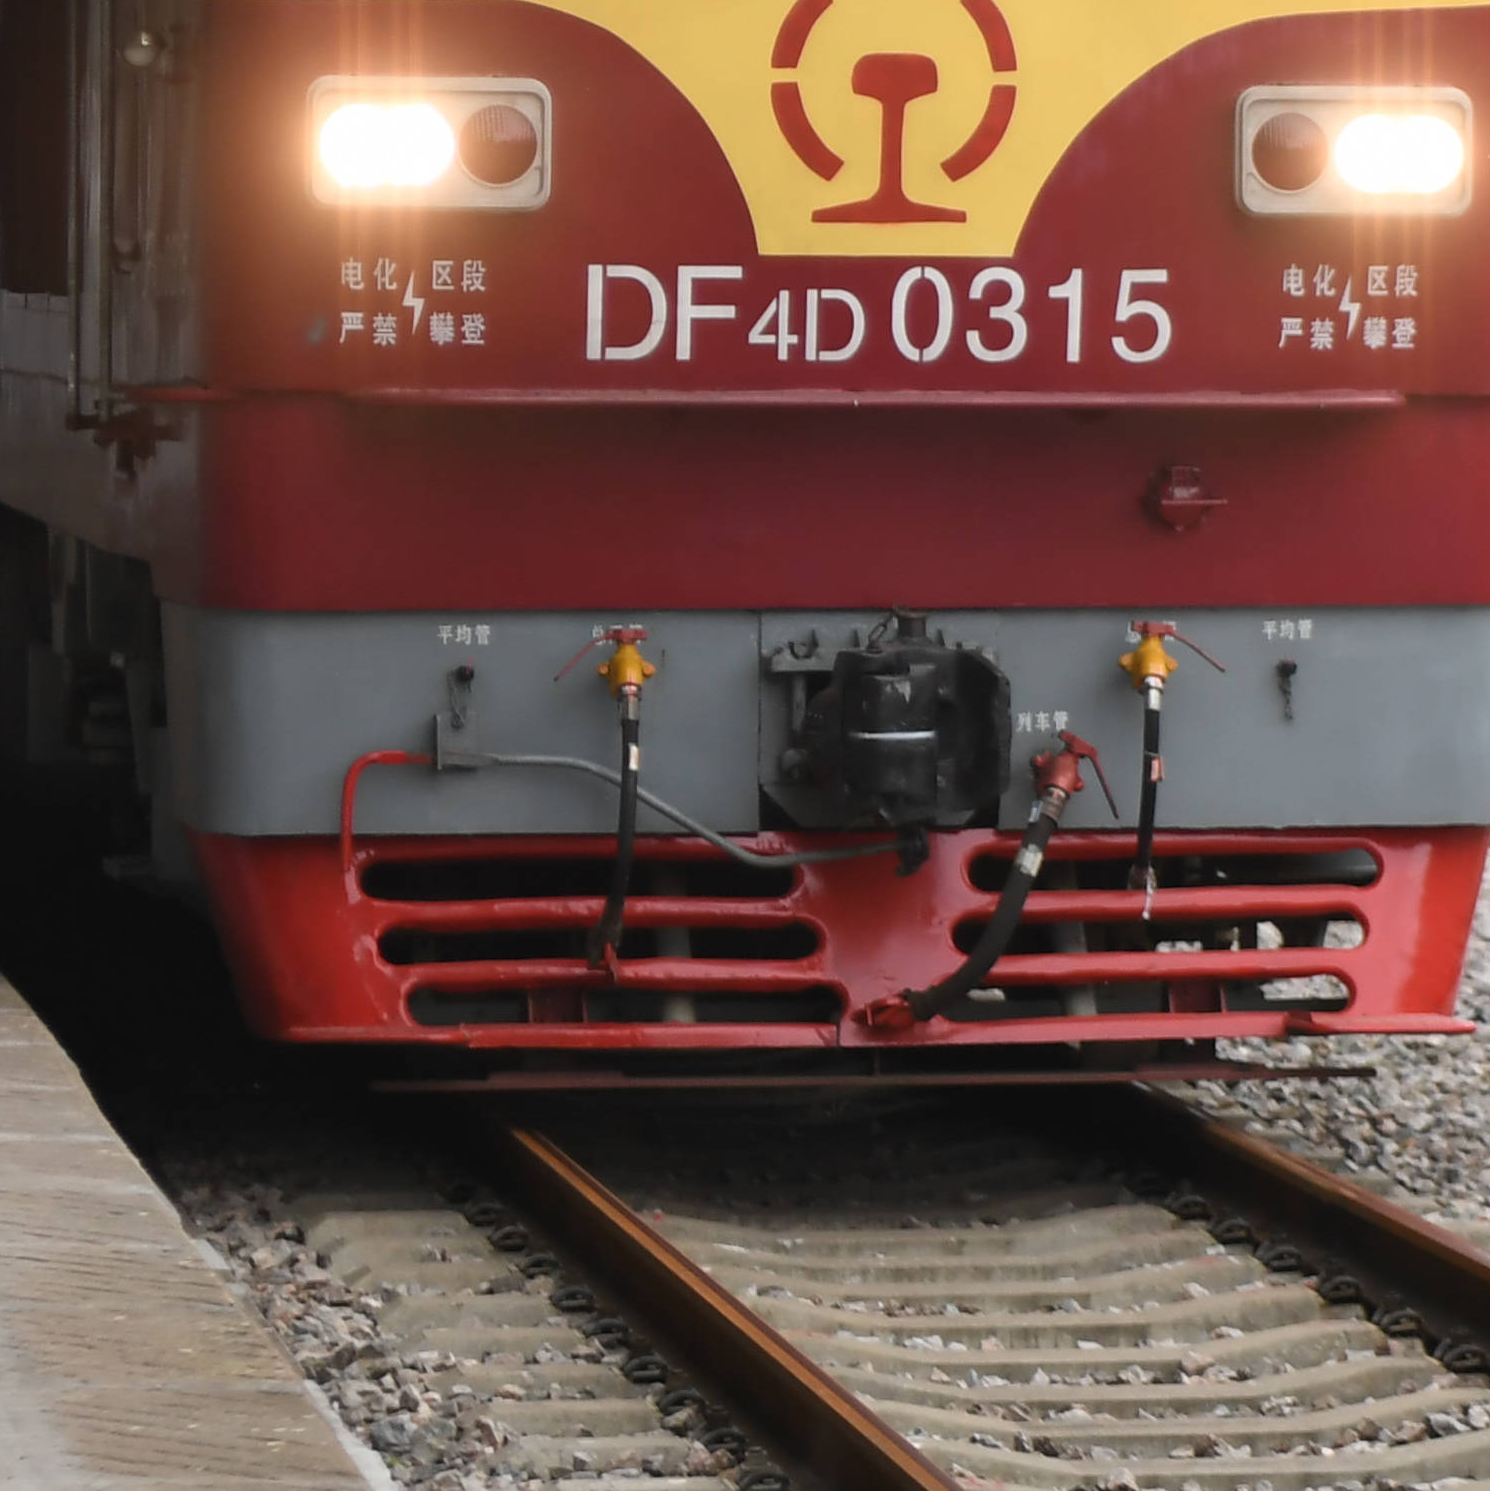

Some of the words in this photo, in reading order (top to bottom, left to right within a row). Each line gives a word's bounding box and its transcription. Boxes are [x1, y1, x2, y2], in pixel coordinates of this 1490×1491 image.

[436, 624, 491, 646] 平均管
[1261, 619, 1313, 640] 平均管
[1016, 710, 1069, 733] 列车管
